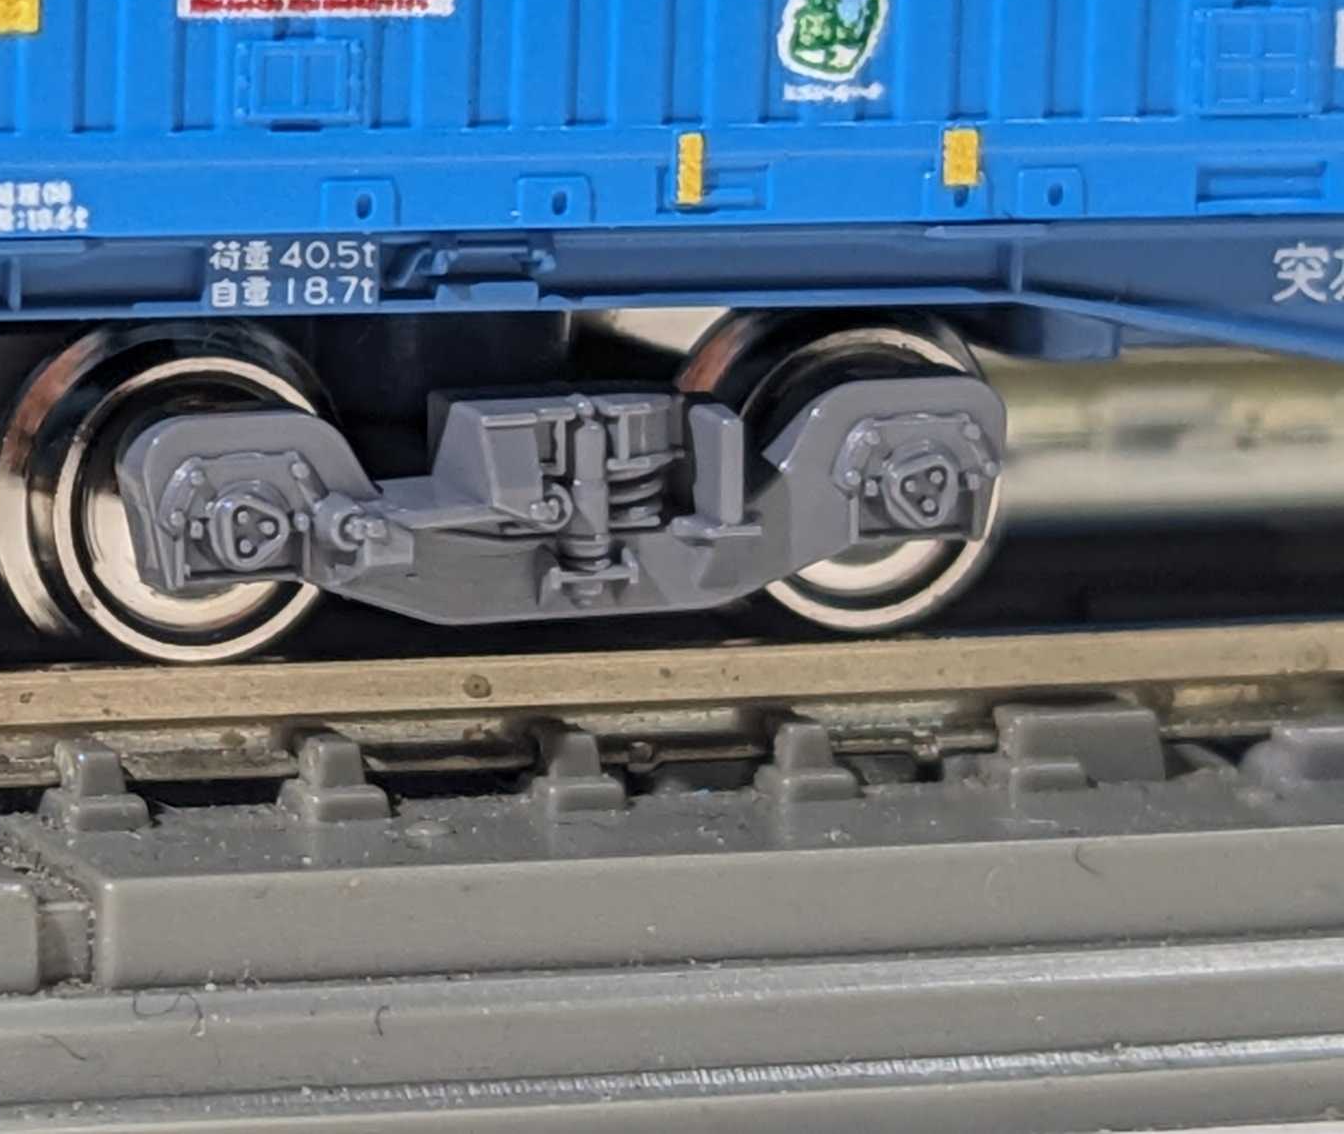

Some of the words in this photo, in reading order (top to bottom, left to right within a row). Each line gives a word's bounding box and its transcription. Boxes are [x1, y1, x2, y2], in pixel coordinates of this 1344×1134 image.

[209, 239, 272, 271] 荷重
[279, 240, 376, 270] 40.5t
[1272, 241, 1344, 303] 突
[211, 277, 272, 308] 自重
[286, 276, 375, 306] 18.7t
